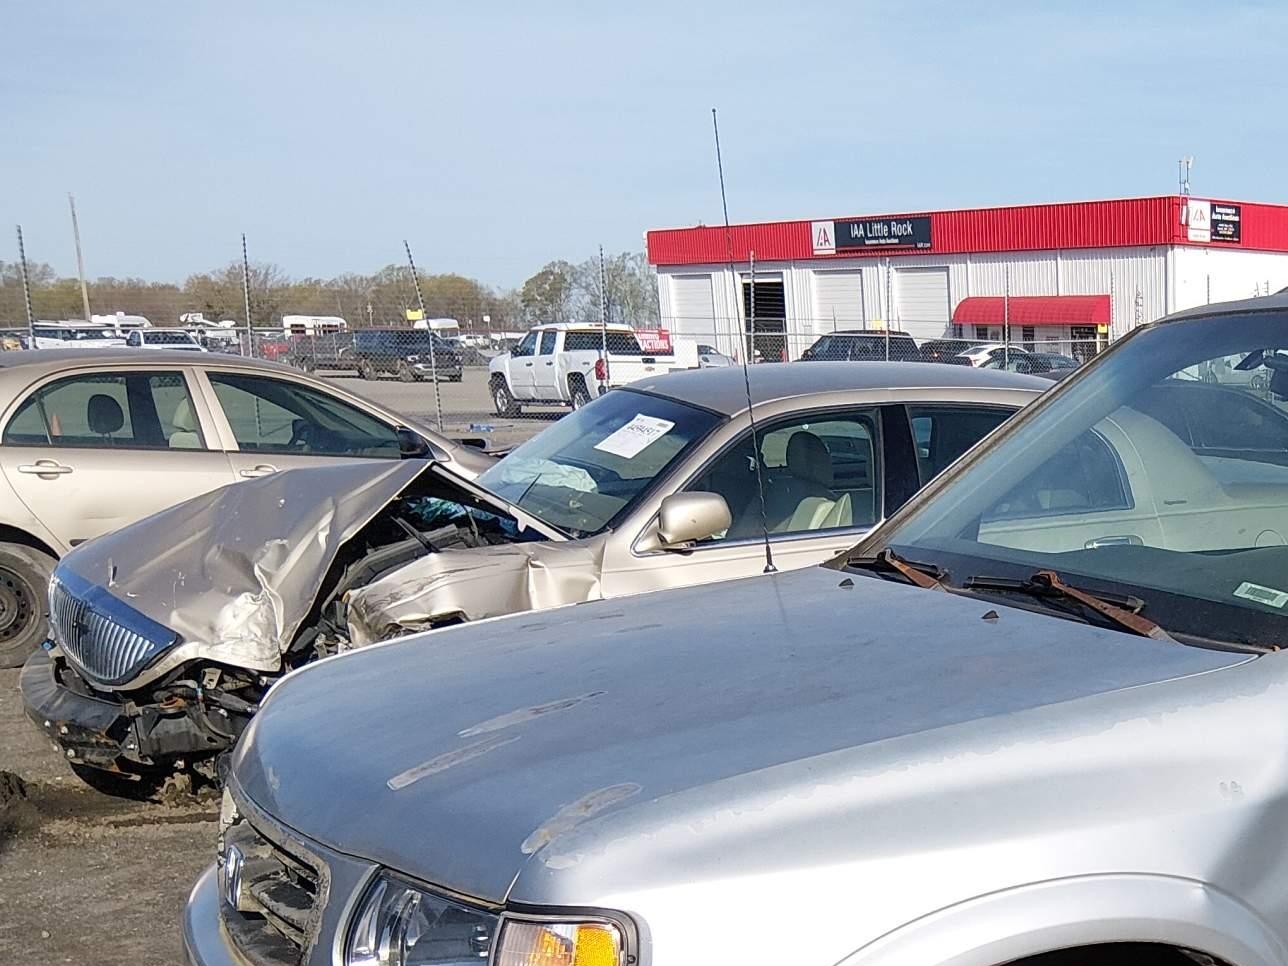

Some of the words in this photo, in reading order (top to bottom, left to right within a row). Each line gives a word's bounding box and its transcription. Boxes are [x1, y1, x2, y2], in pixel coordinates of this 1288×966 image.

[850, 223, 865, 238] IAA
[867, 222, 888, 237] Little
[891, 220, 913, 236] Rock
